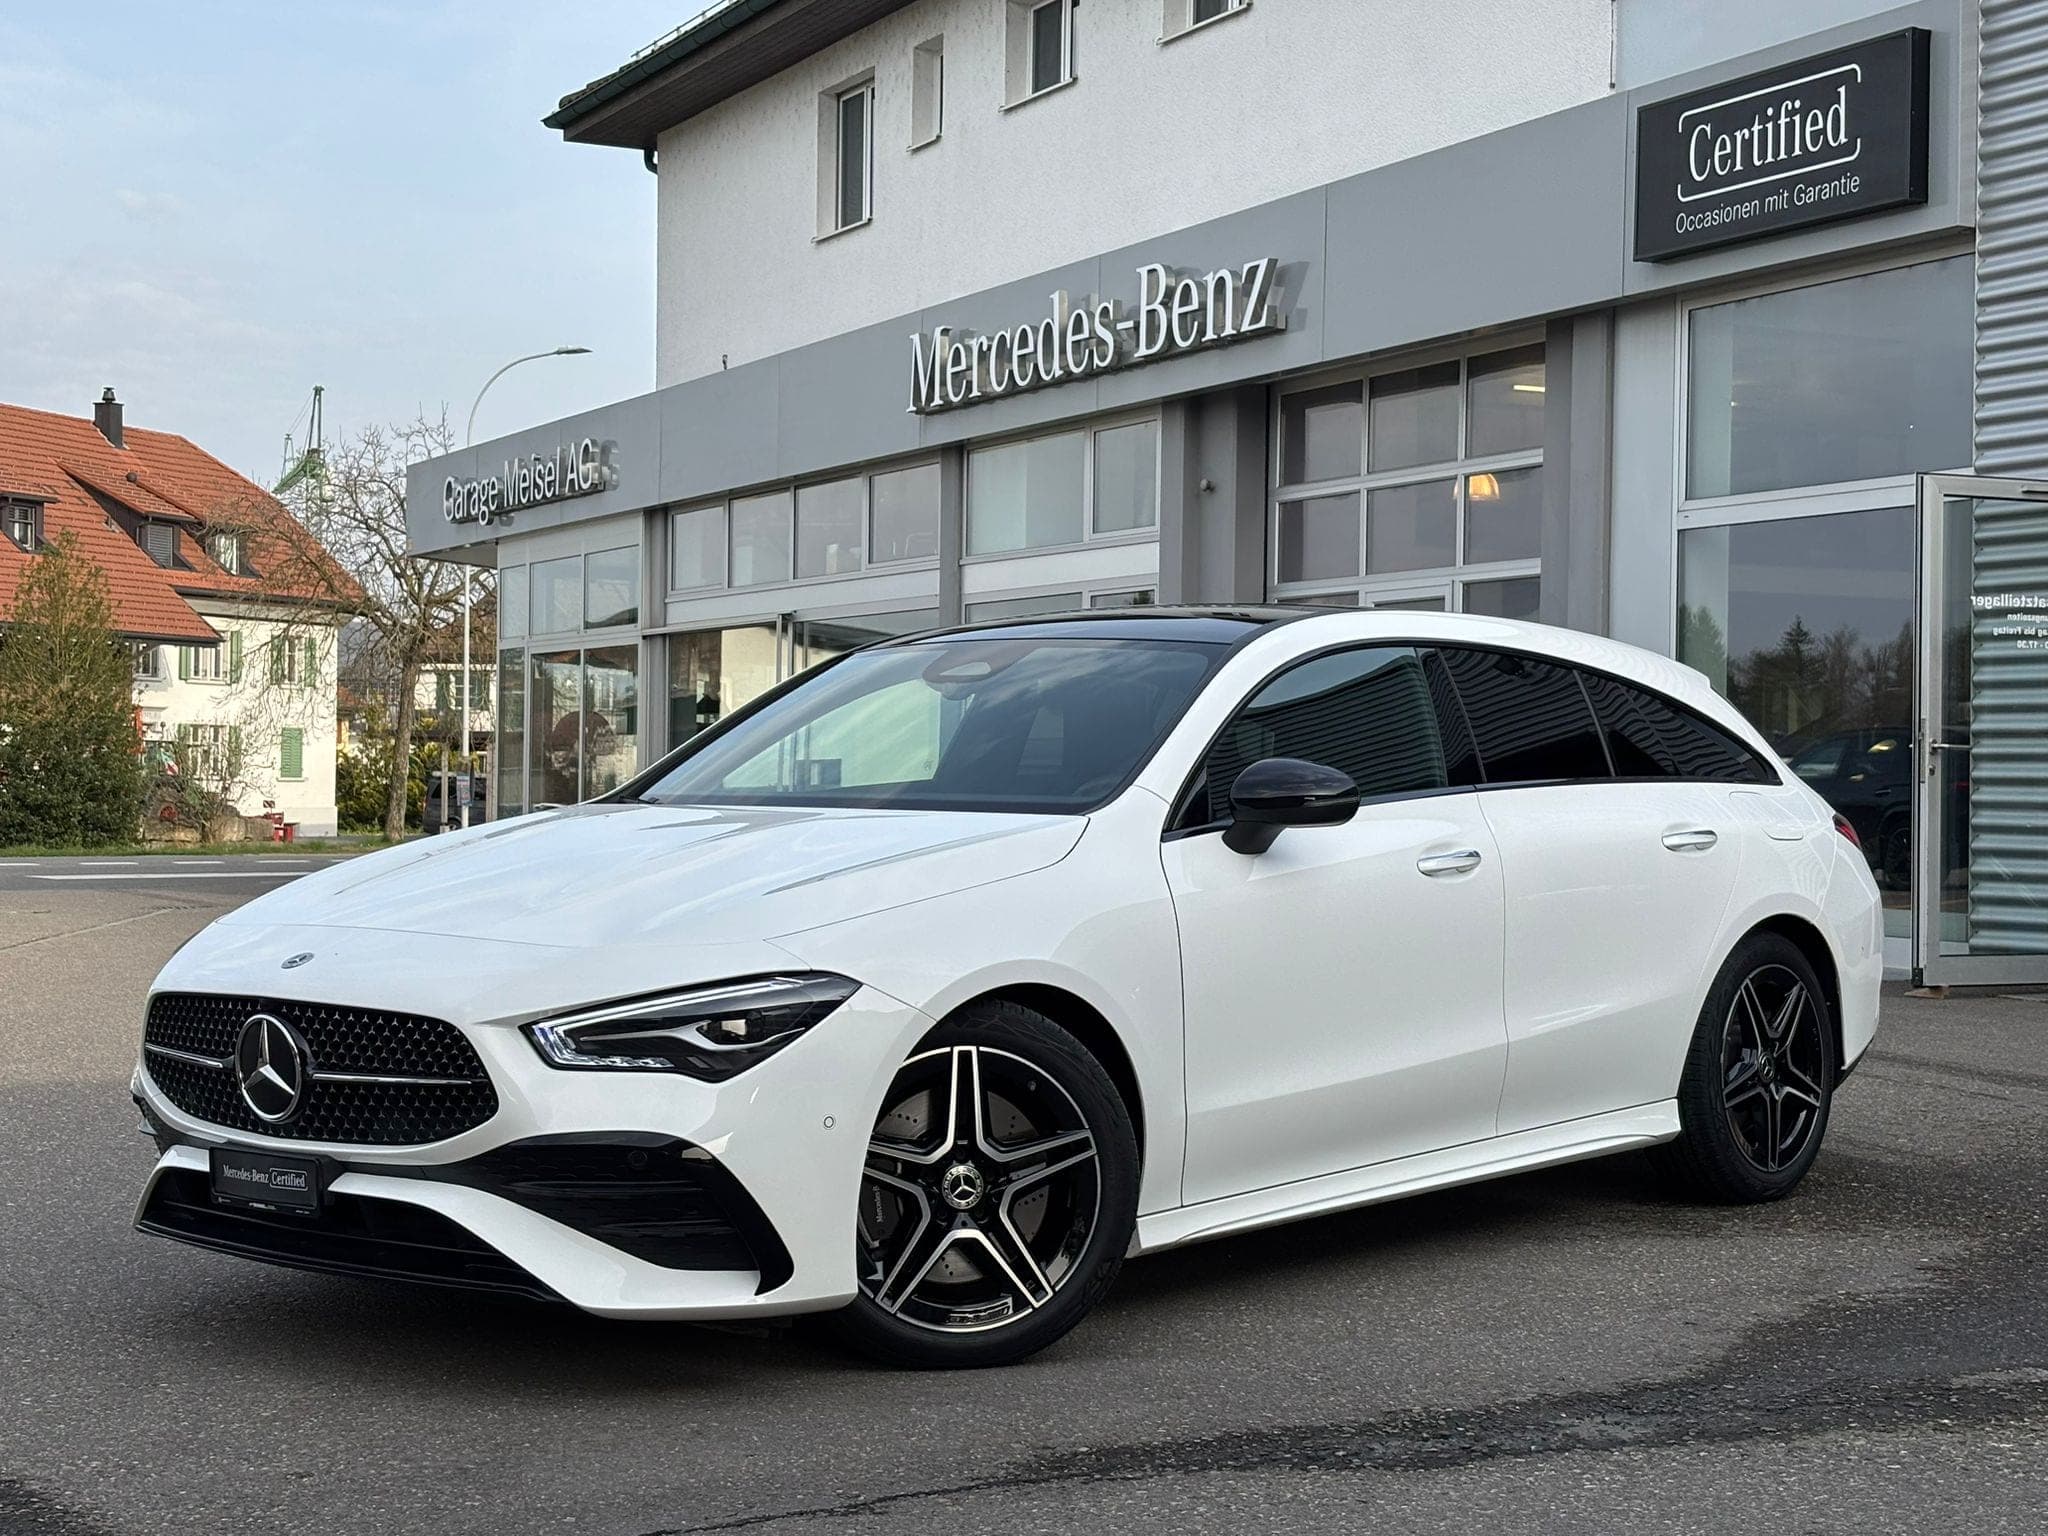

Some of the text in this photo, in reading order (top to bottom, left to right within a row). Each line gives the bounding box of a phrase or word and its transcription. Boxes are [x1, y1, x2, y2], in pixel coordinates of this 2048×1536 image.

[1689, 85, 1849, 182] Certified
[1675, 172, 1860, 234] Occasionen mit Garantie
[906, 257, 1279, 414] Mercedes-Benz
[443, 438, 593, 525] Garage Meisel AG
[223, 1164, 306, 1188] Mercedes-Benz Certified
